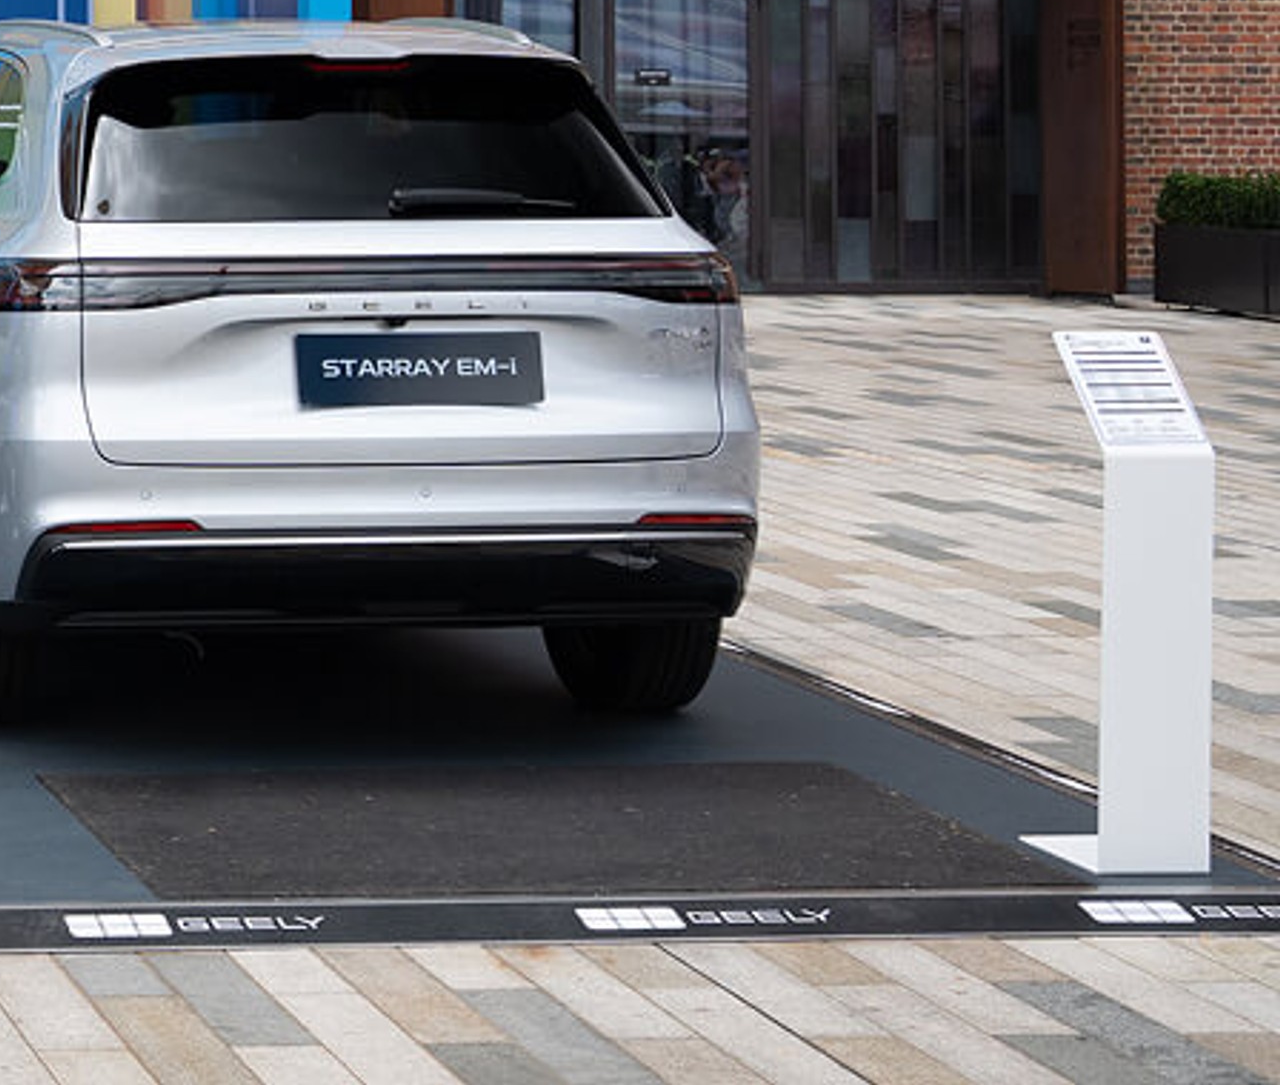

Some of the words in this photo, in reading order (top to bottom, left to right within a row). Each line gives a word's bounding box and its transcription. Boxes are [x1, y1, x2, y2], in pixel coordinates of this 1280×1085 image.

[321, 358, 451, 379] STARRAY
[456, 357, 518, 377] EM-i
[177, 915, 325, 932] GEELY
[687, 908, 831, 925] GEELY
